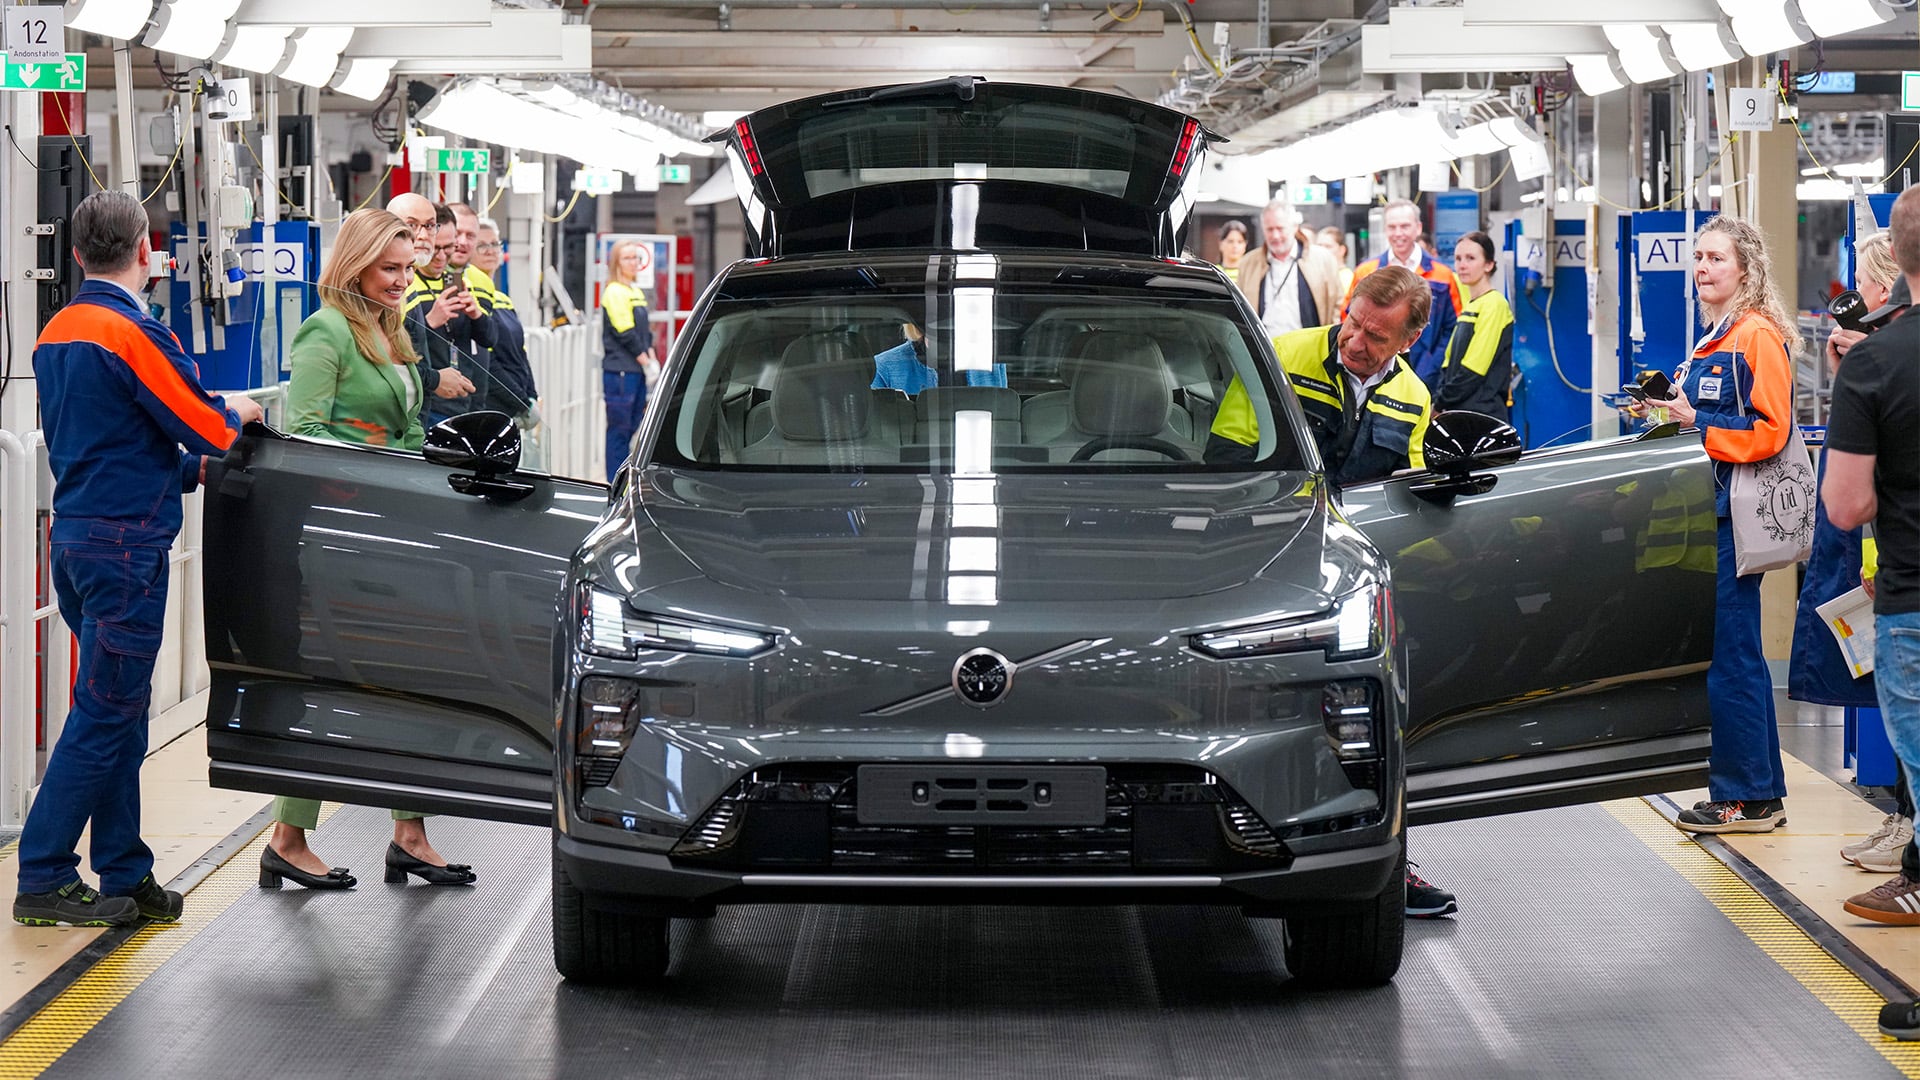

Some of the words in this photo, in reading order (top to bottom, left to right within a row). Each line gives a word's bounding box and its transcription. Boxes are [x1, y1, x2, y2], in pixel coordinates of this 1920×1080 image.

[22, 19, 47, 44] 12
[1515, 91, 1527, 106] 16
[1746, 98, 1756, 117] 9
[959, 674, 1005, 683] VOLVO
